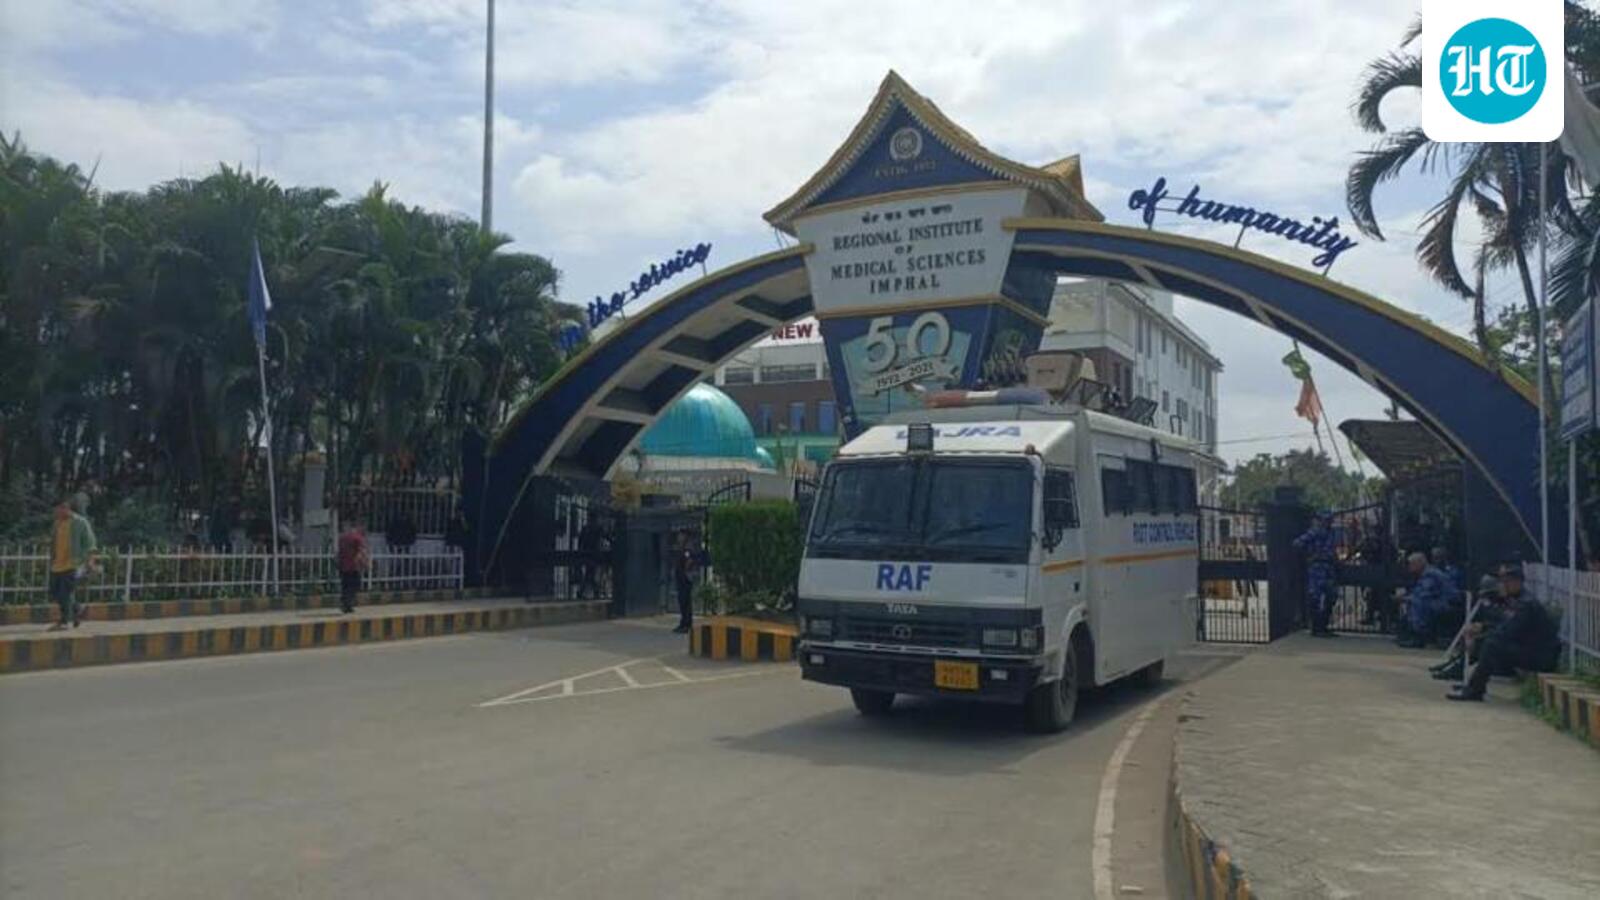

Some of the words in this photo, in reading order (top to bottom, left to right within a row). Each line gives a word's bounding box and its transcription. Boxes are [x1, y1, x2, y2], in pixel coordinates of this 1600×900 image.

[832, 229, 902, 250] REGIONAL
[908, 218, 984, 241] INSTITUTE
[1128, 177, 1168, 225] of
[1177, 184, 1358, 267] humanity
[894, 245, 914, 255] OF
[831, 260, 897, 281] MEDICAL
[907, 249, 986, 272] SCIENCES
[586, 292, 626, 329] the
[631, 242, 712, 299] service
[870, 274, 940, 294] IMPHAL
[772, 323, 813, 340] NEW
[863, 312, 951, 372] 50
[876, 564, 933, 591] RAF
[886, 603, 918, 614] TATA
